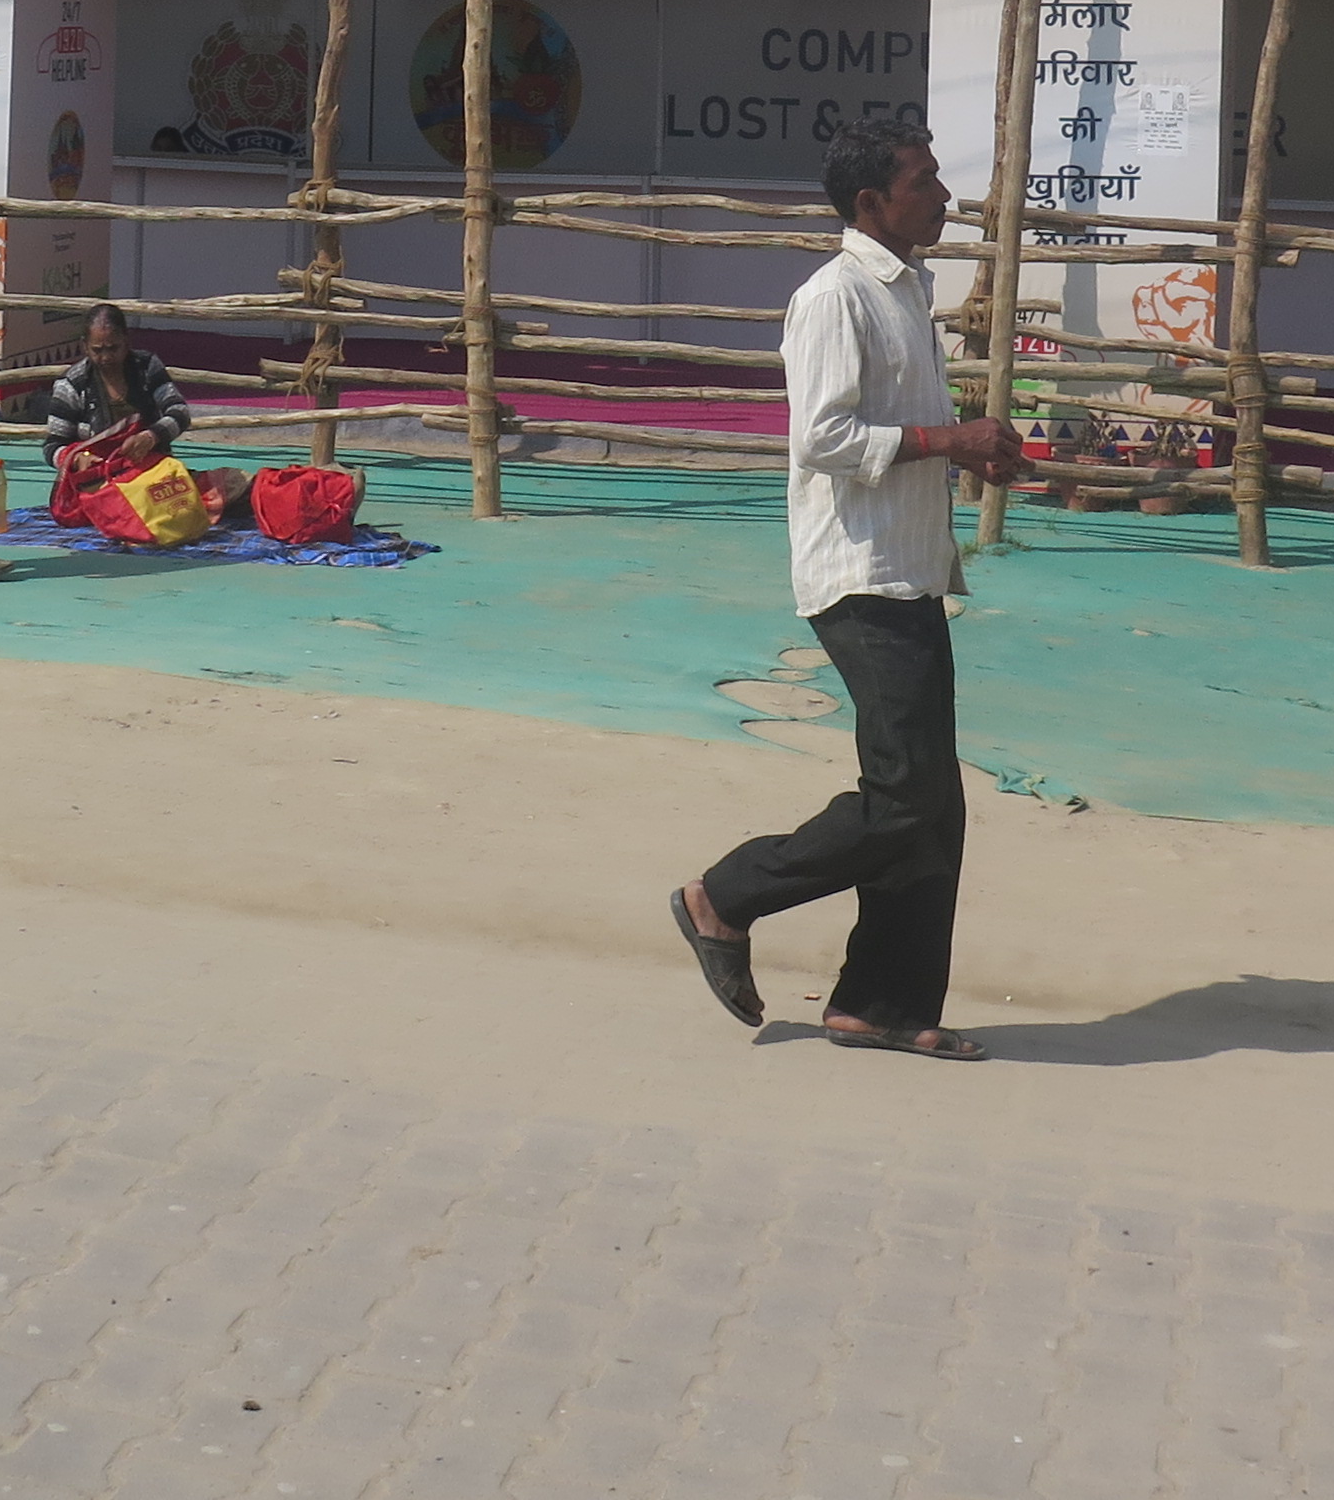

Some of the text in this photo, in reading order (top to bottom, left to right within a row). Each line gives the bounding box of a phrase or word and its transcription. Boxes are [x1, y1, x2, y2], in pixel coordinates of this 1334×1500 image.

[761, 27, 928, 74] COMP
[666, 94, 800, 140] LOST
[811, 99, 844, 142] &
[1059, 107, 1102, 142] की
[234, 130, 282, 150] प्रदेश
